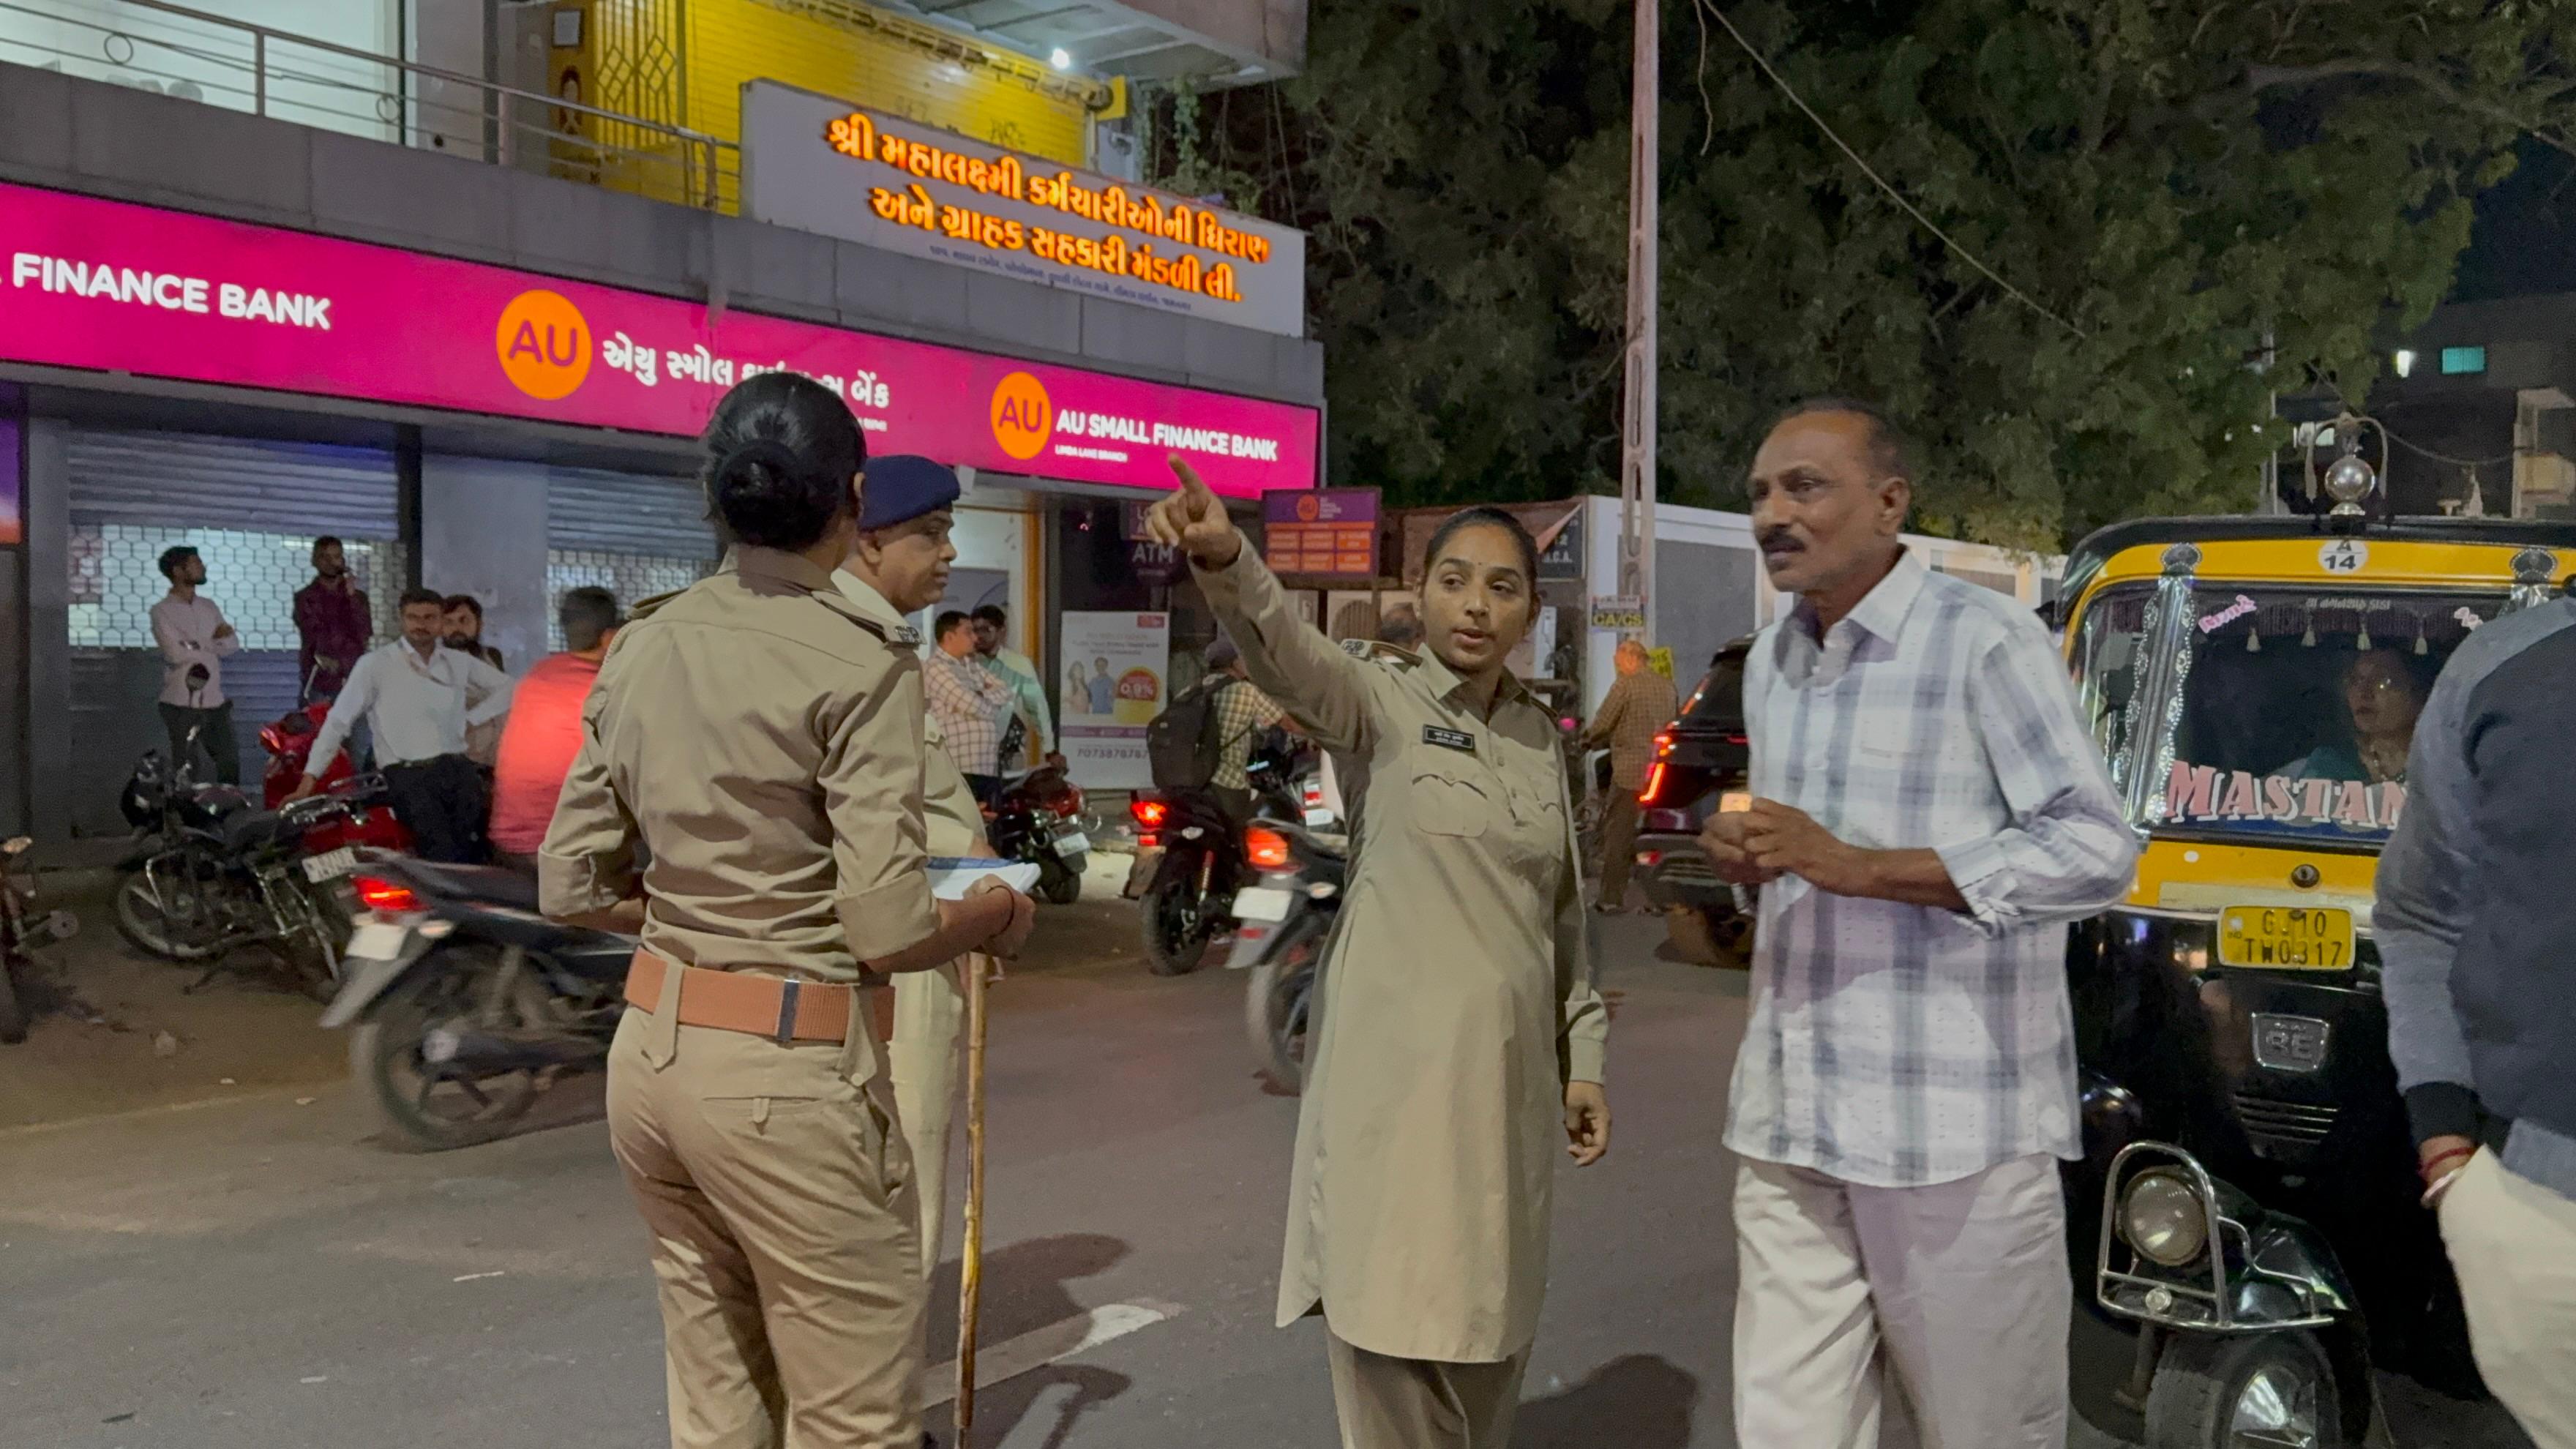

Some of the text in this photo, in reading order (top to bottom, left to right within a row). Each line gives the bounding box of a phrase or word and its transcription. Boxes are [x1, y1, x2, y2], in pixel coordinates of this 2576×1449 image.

[825, 112, 875, 161] શ્રી
[880, 133, 1022, 200] મહાલક્ષ્મી
[1029, 171, 1193, 244] કર્મચારીઓની
[1197, 210, 1270, 264] ધિરાણ
[872, 182, 935, 231] અને
[941, 204, 1024, 250] ગ્રાહક
[1030, 225, 1128, 276] સહકારી
[1131, 243, 1202, 293] મંડળી
[1205, 261, 1243, 302] લી.
[12, 252, 332, 331] FINANCE BANK
[508, 318, 578, 368] AU
[602, 331, 658, 387] એયુ
[666, 343, 733, 386] સ્મોલ
[850, 369, 890, 408] બેંક
[997, 396, 1043, 434] AU
[1056, 408, 1278, 462] AU SMALL FINANCE BANK
[1131, 542, 1174, 564] ATM
[2324, 554, 2356, 570] 14
[1592, 611, 1644, 627] CA/CS
